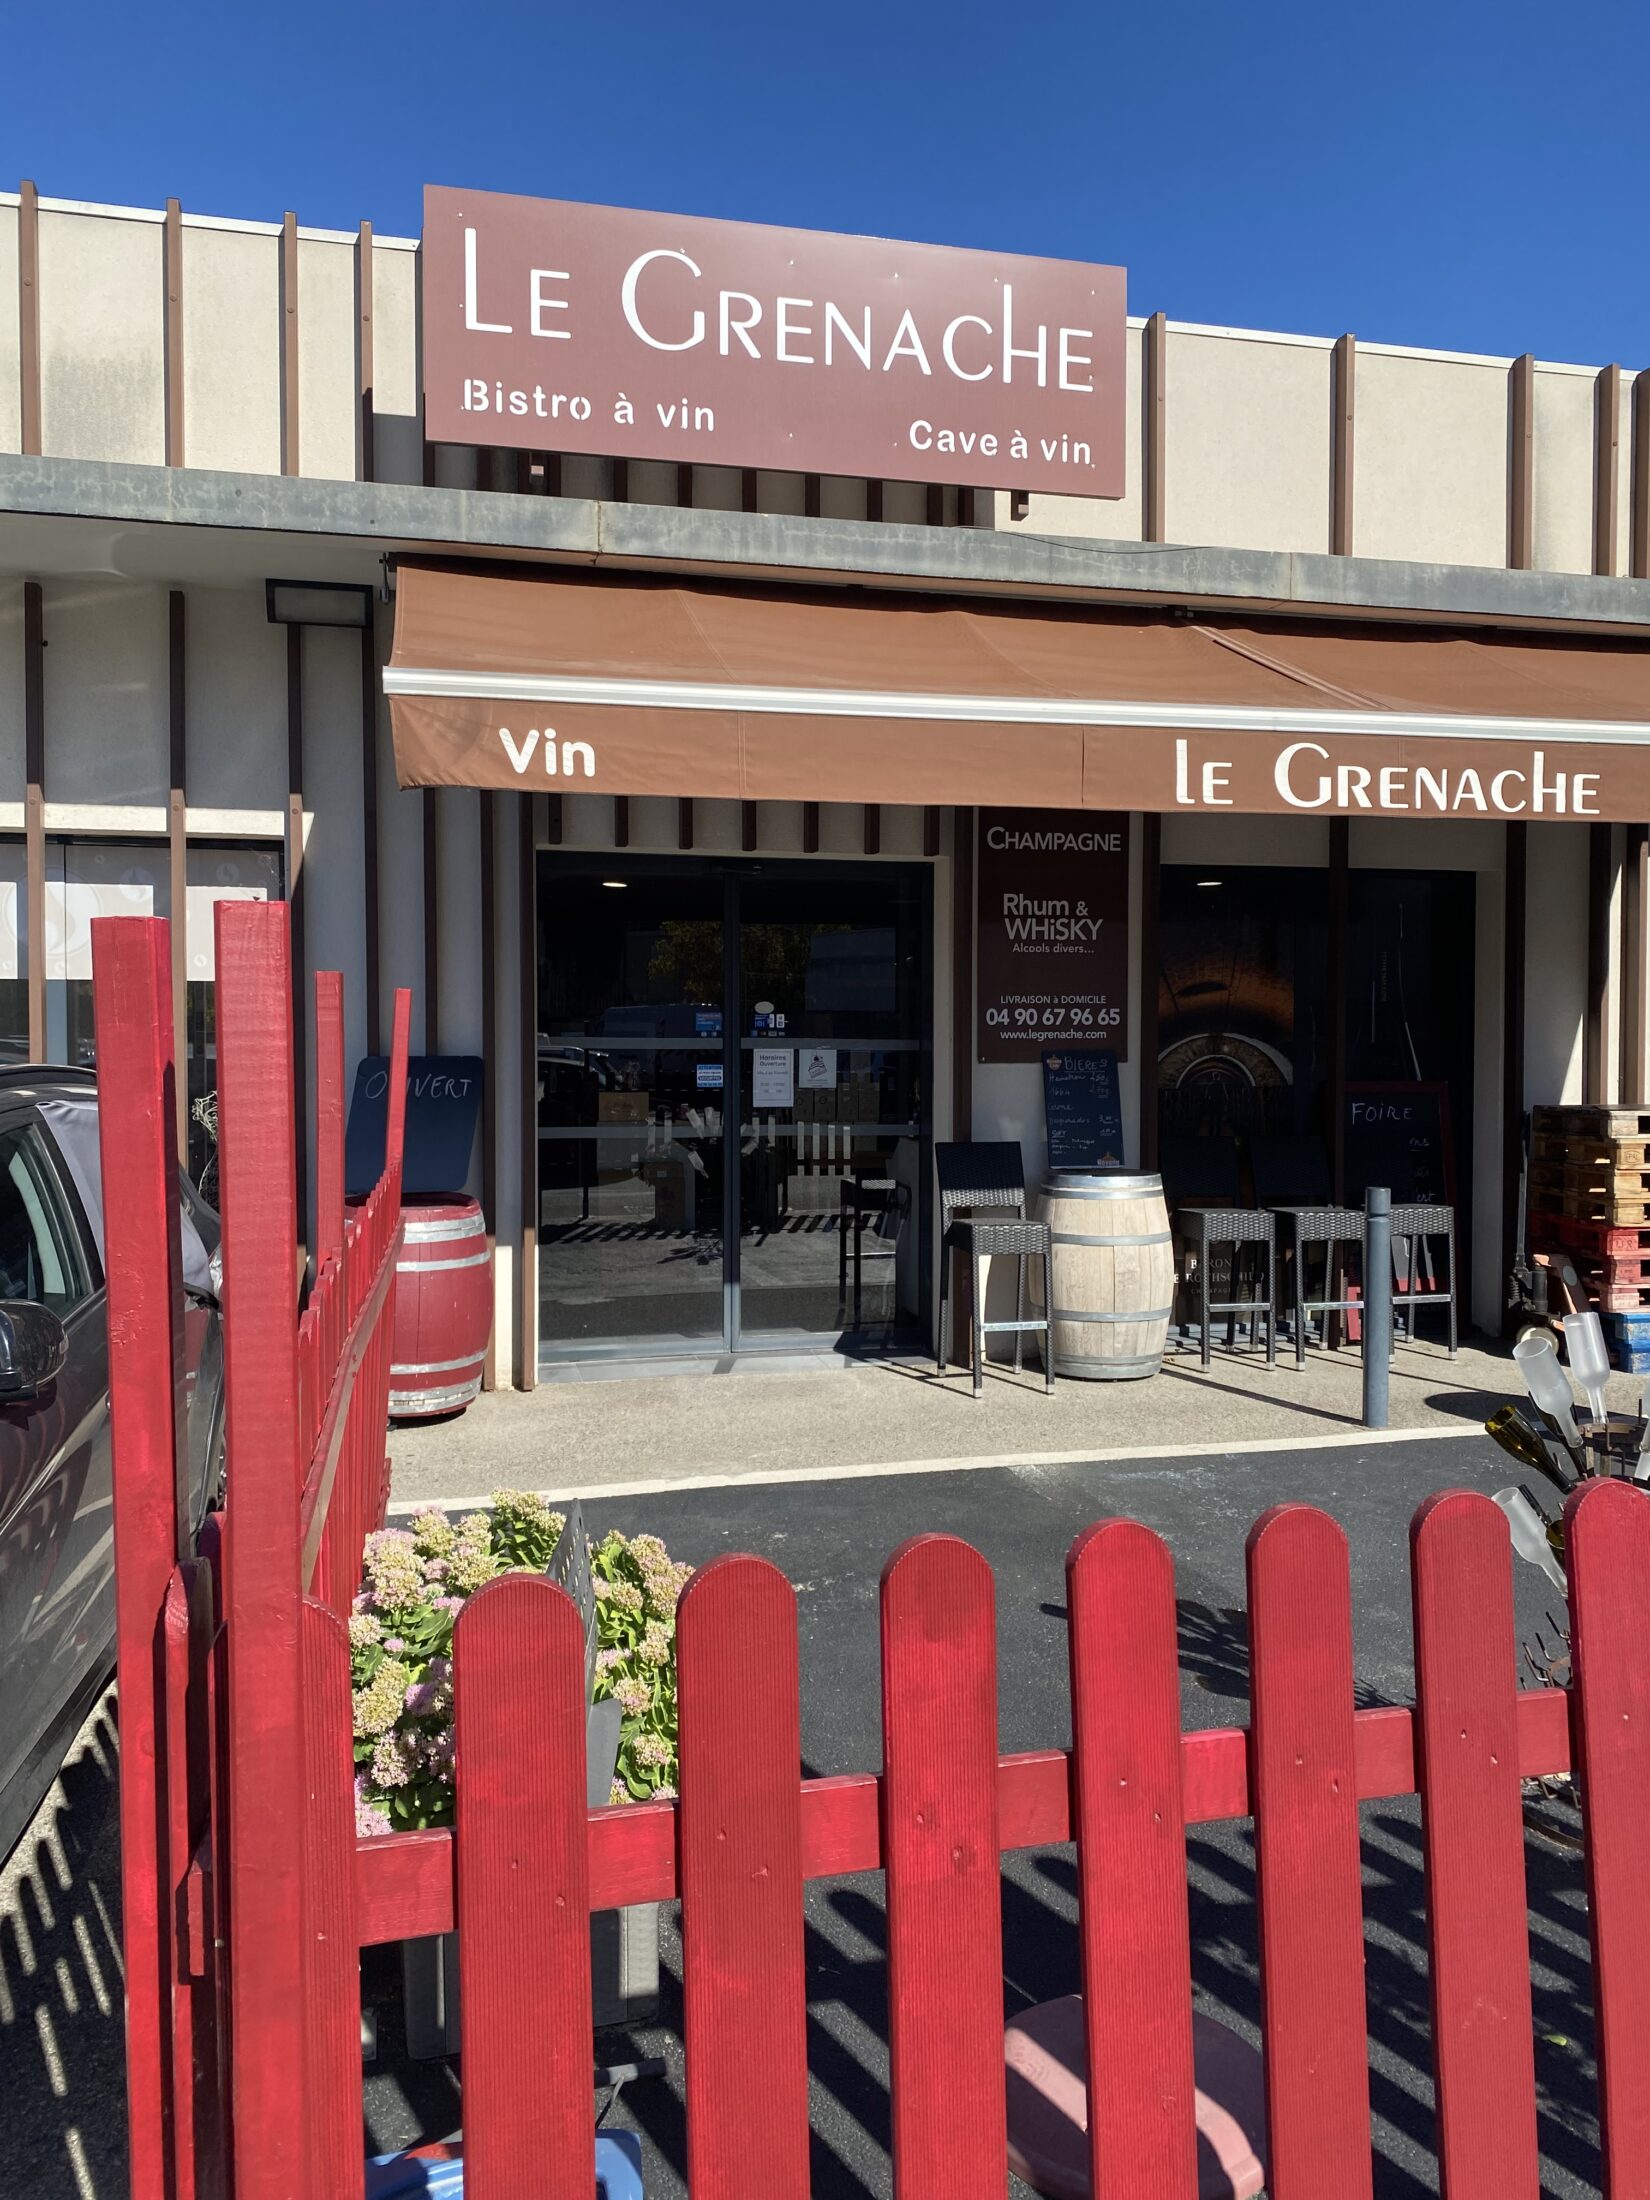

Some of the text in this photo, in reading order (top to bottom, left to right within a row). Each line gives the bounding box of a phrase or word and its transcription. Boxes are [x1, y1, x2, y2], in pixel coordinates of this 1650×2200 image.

[464, 227, 1094, 393] LE GRENACHE
[463, 378, 716, 432] Bistro à vin
[909, 419, 1092, 466] Cave à vin
[499, 727, 596, 777] Vin
[1175, 739, 1601, 815] LE GRENACHE
[987, 826, 1122, 852] CHAMPAGNE
[1003, 893, 1089, 917] Rhum &
[1012, 942, 1050, 953] Alcools
[1000, 995, 1051, 1004] LIVRAISON
[1061, 995, 1107, 1004] DOMICILE
[986, 1008, 1121, 1025] 04 90 67 96 65
[1000, 1028, 1107, 1042] www.legrenache.com
[365, 1070, 473, 1099] OVERT
[1190, 1259, 1232, 1270] BRON
